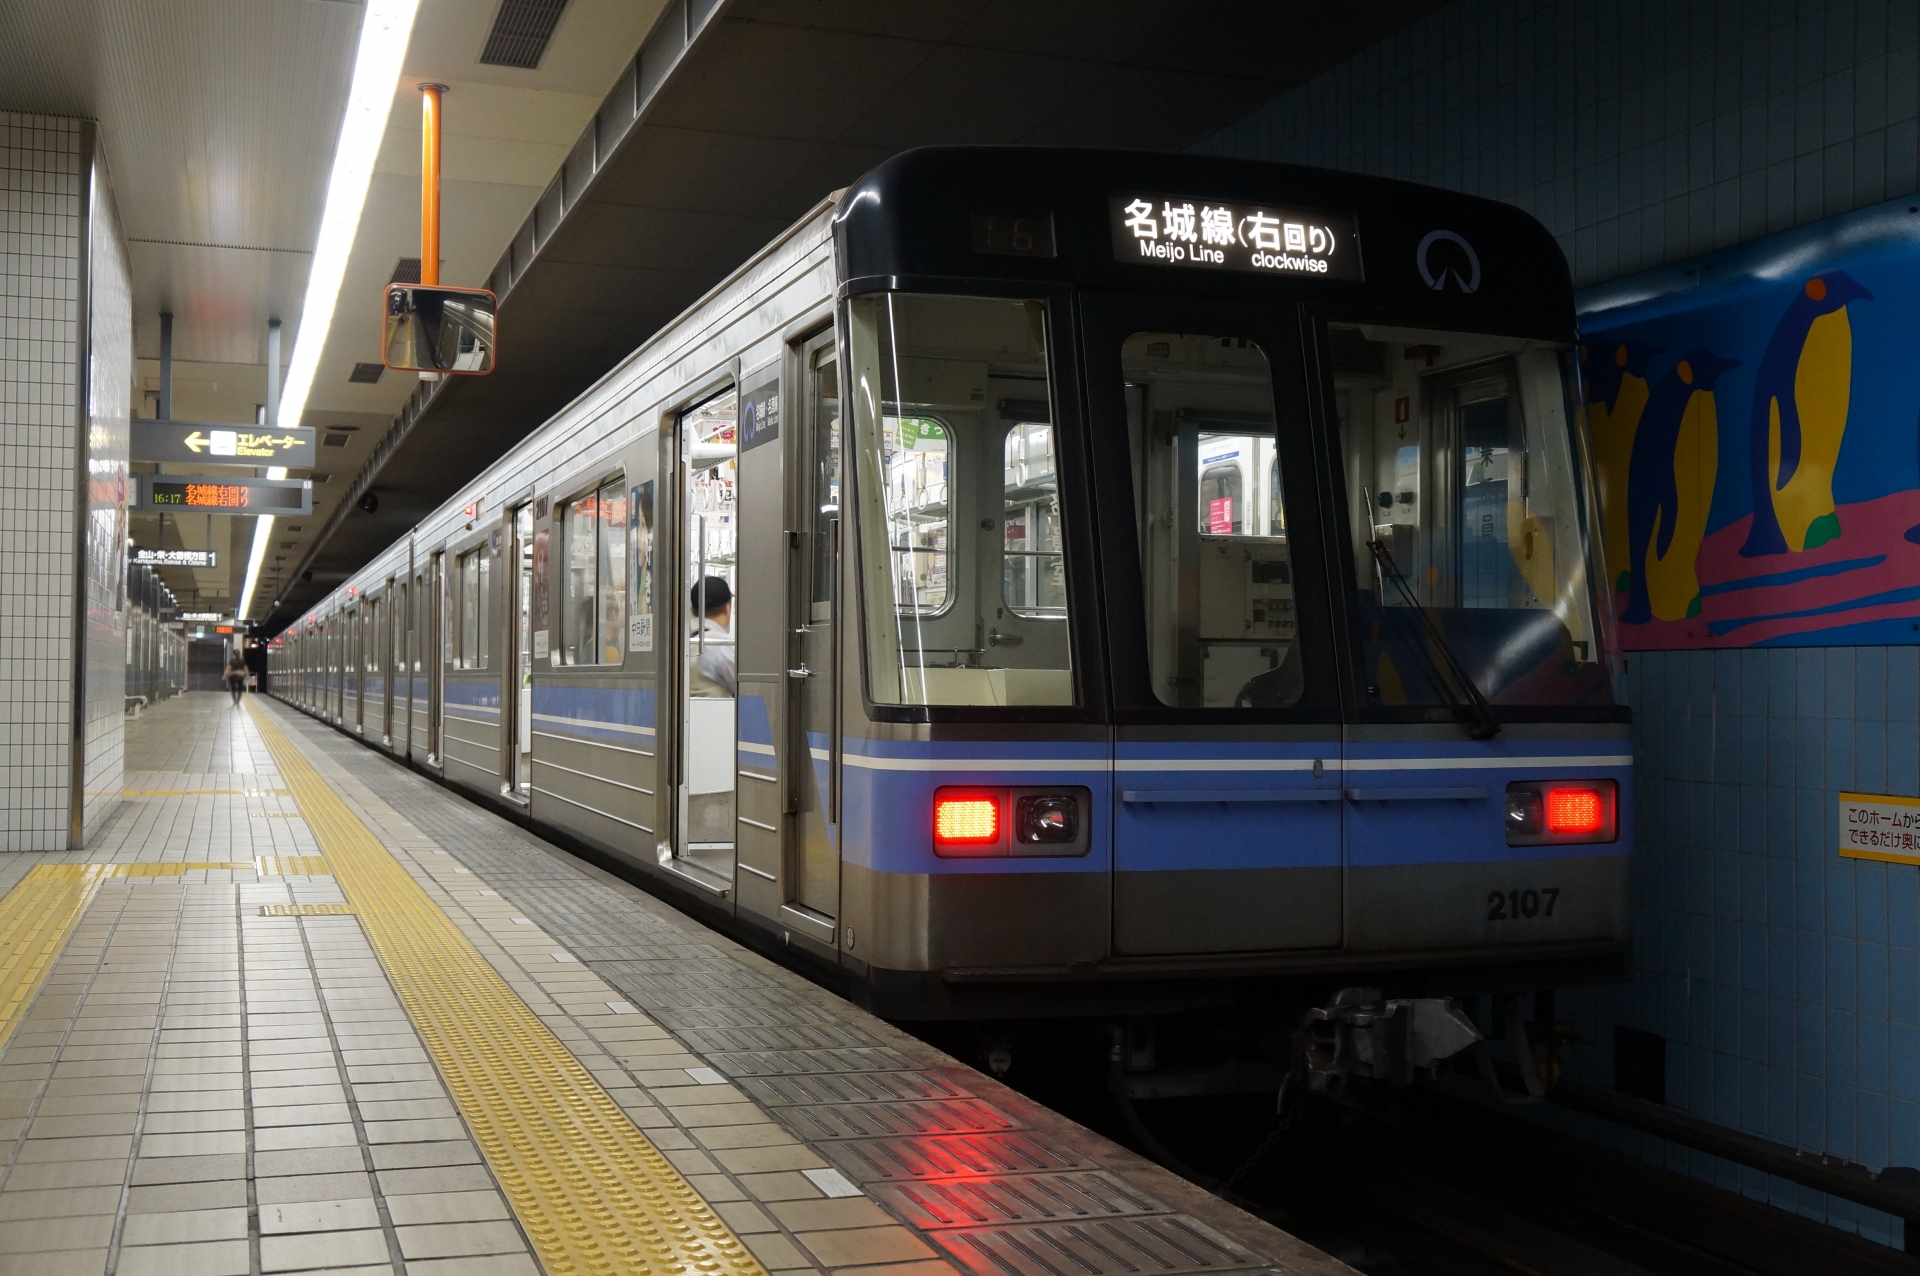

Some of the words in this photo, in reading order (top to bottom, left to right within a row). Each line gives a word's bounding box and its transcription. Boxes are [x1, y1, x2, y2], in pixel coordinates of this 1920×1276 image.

[1139, 239, 1185, 263] Meijo
[1189, 243, 1225, 264] Line
[1250, 251, 1329, 273] clockwise
[237, 433, 306, 449] エレベーター
[237, 447, 275, 457] Elevator
[185, 483, 249, 497] 名城線右回り
[154, 493, 182, 504] 16:17
[208, 551, 216, 567] 1
[1486, 887, 1560, 922] 2107
